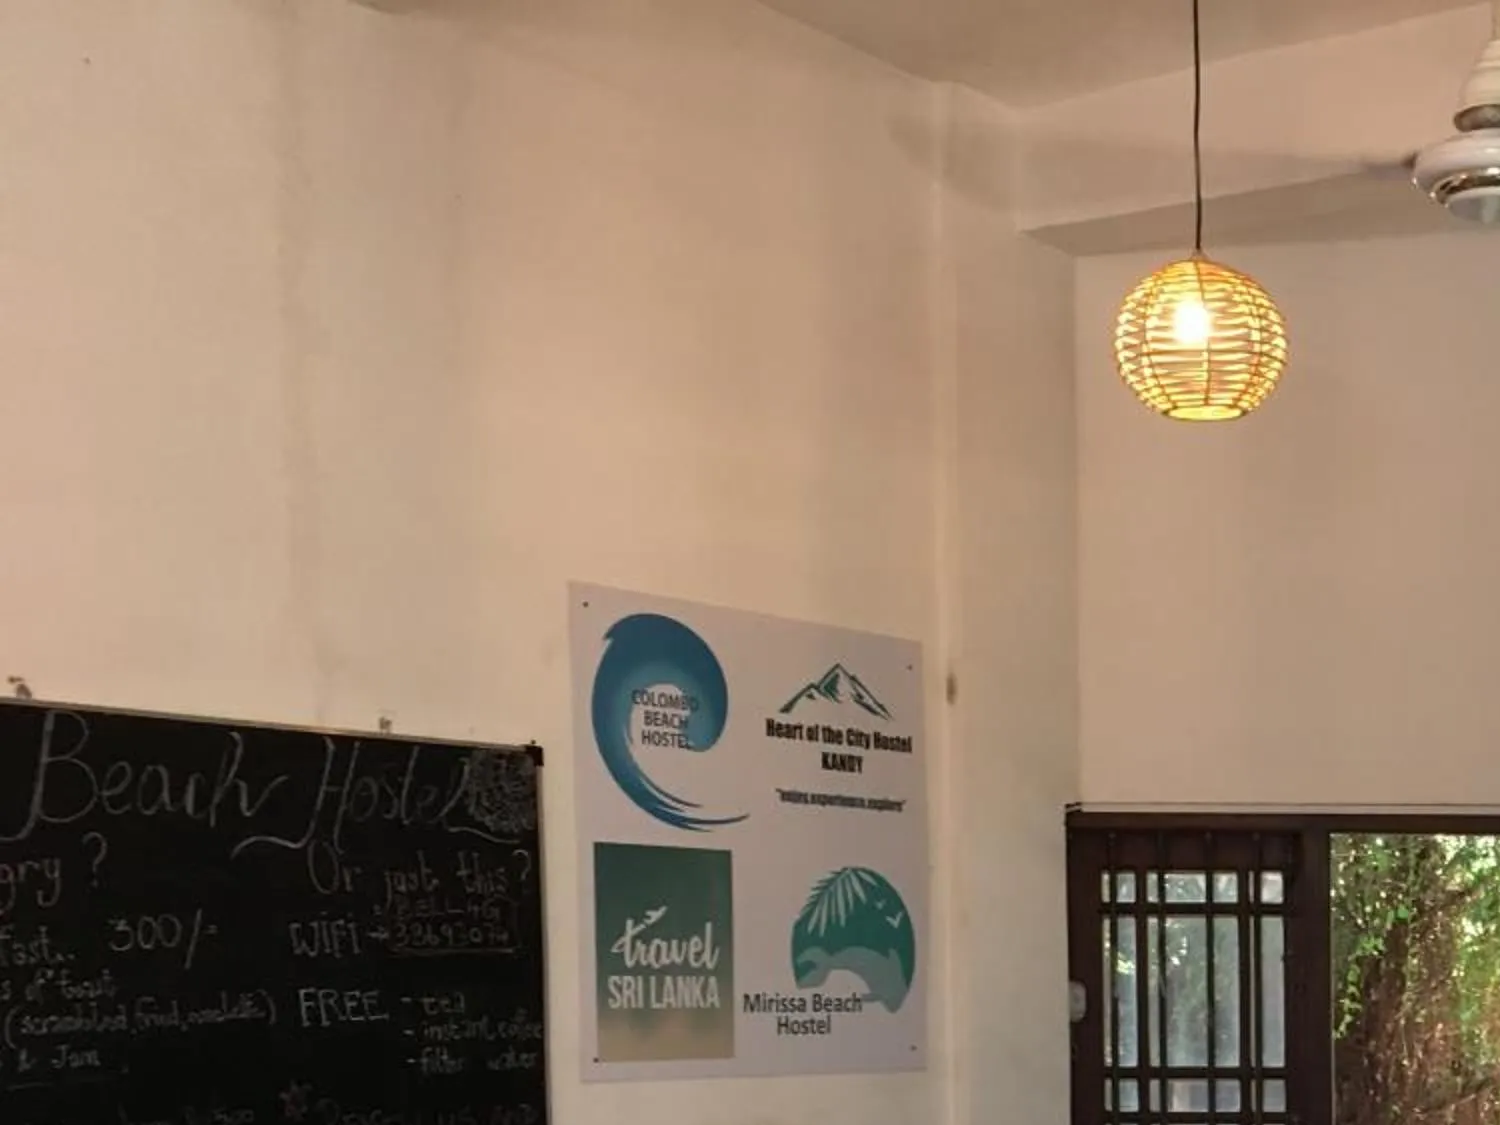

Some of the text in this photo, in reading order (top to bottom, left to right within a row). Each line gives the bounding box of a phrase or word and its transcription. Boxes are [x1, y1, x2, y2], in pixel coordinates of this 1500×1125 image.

[643, 709, 689, 729] BEACH
[641, 729, 693, 750] HOSTEL
[765, 718, 913, 754] Heart of the City Hostel
[8, 710, 288, 836] Beach
[821, 751, 864, 774] KANDY
[610, 916, 720, 970] travel
[608, 975, 721, 1009] SRI LANKA
[743, 992, 863, 1013] Mirissa Beach
[298, 987, 391, 1028] FREE
[777, 1015, 831, 1036] Hostel
